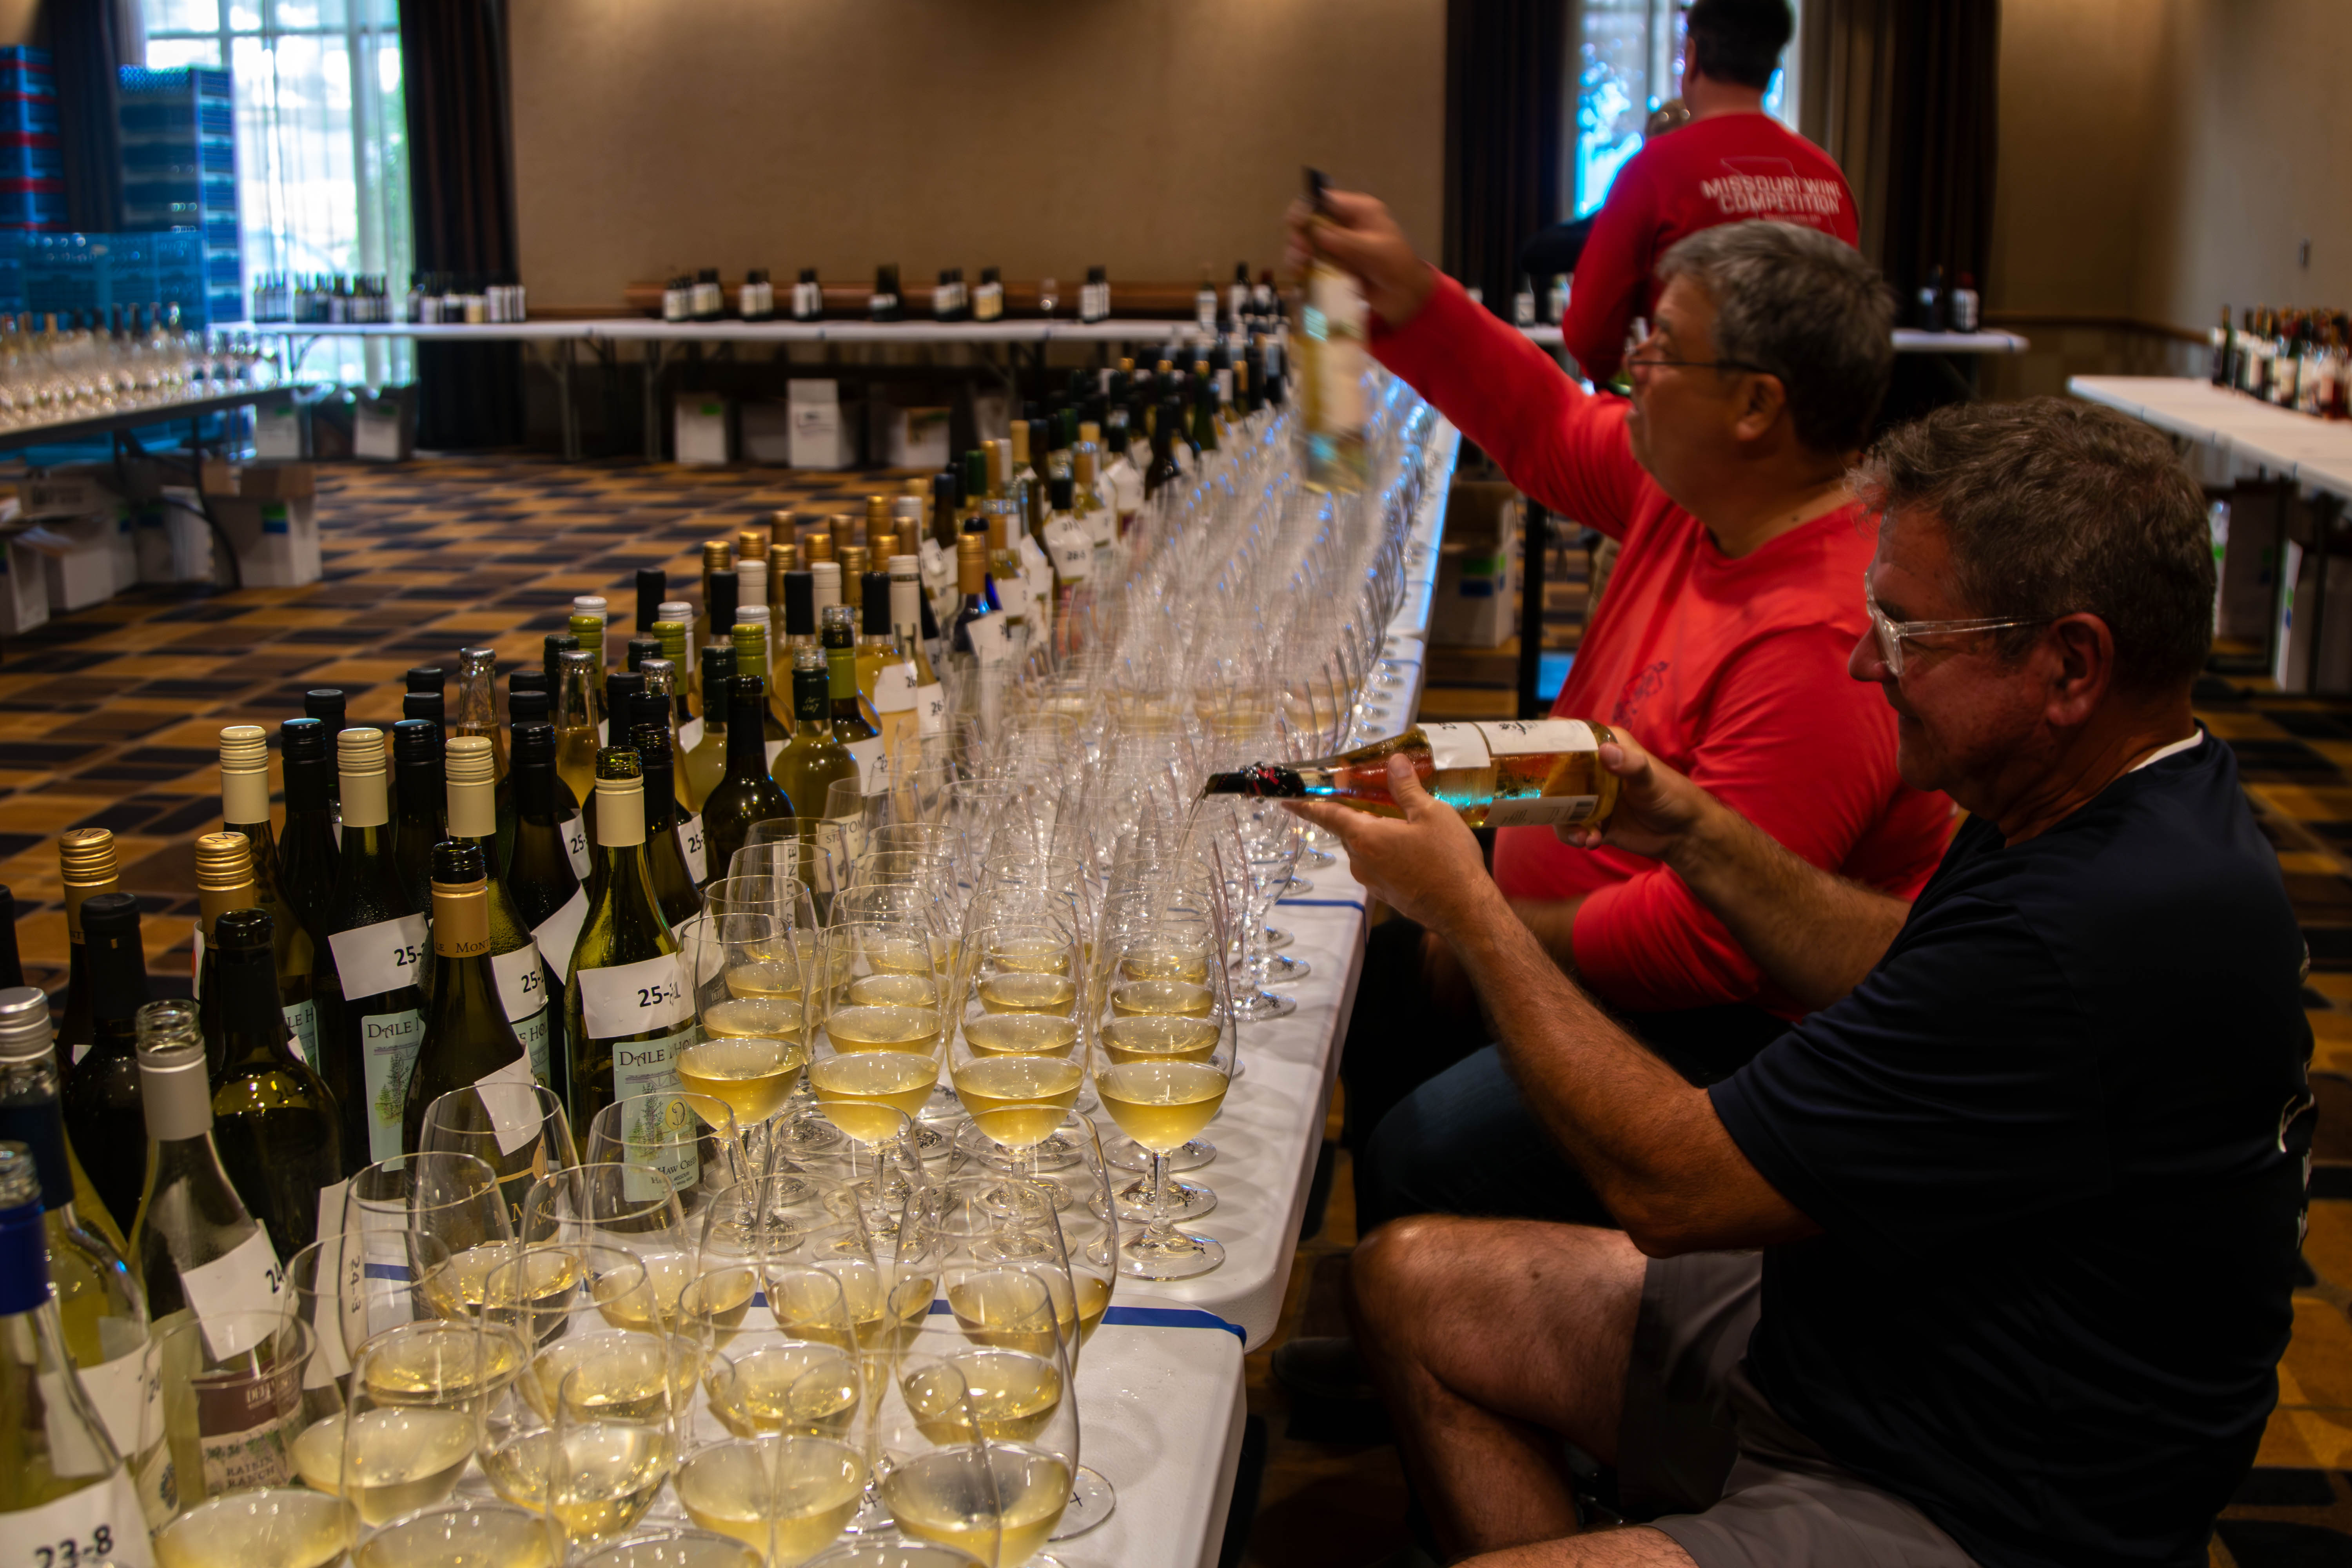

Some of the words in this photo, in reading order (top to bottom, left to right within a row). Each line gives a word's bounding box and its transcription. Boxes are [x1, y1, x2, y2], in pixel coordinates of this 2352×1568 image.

[1700, 174, 1802, 199] MISSOURI
[1719, 192, 1840, 214] COMPETITION
[394, 942, 425, 967] 25-
[367, 1021, 412, 1038] DALE
[619, 1049, 665, 1067] DALE
